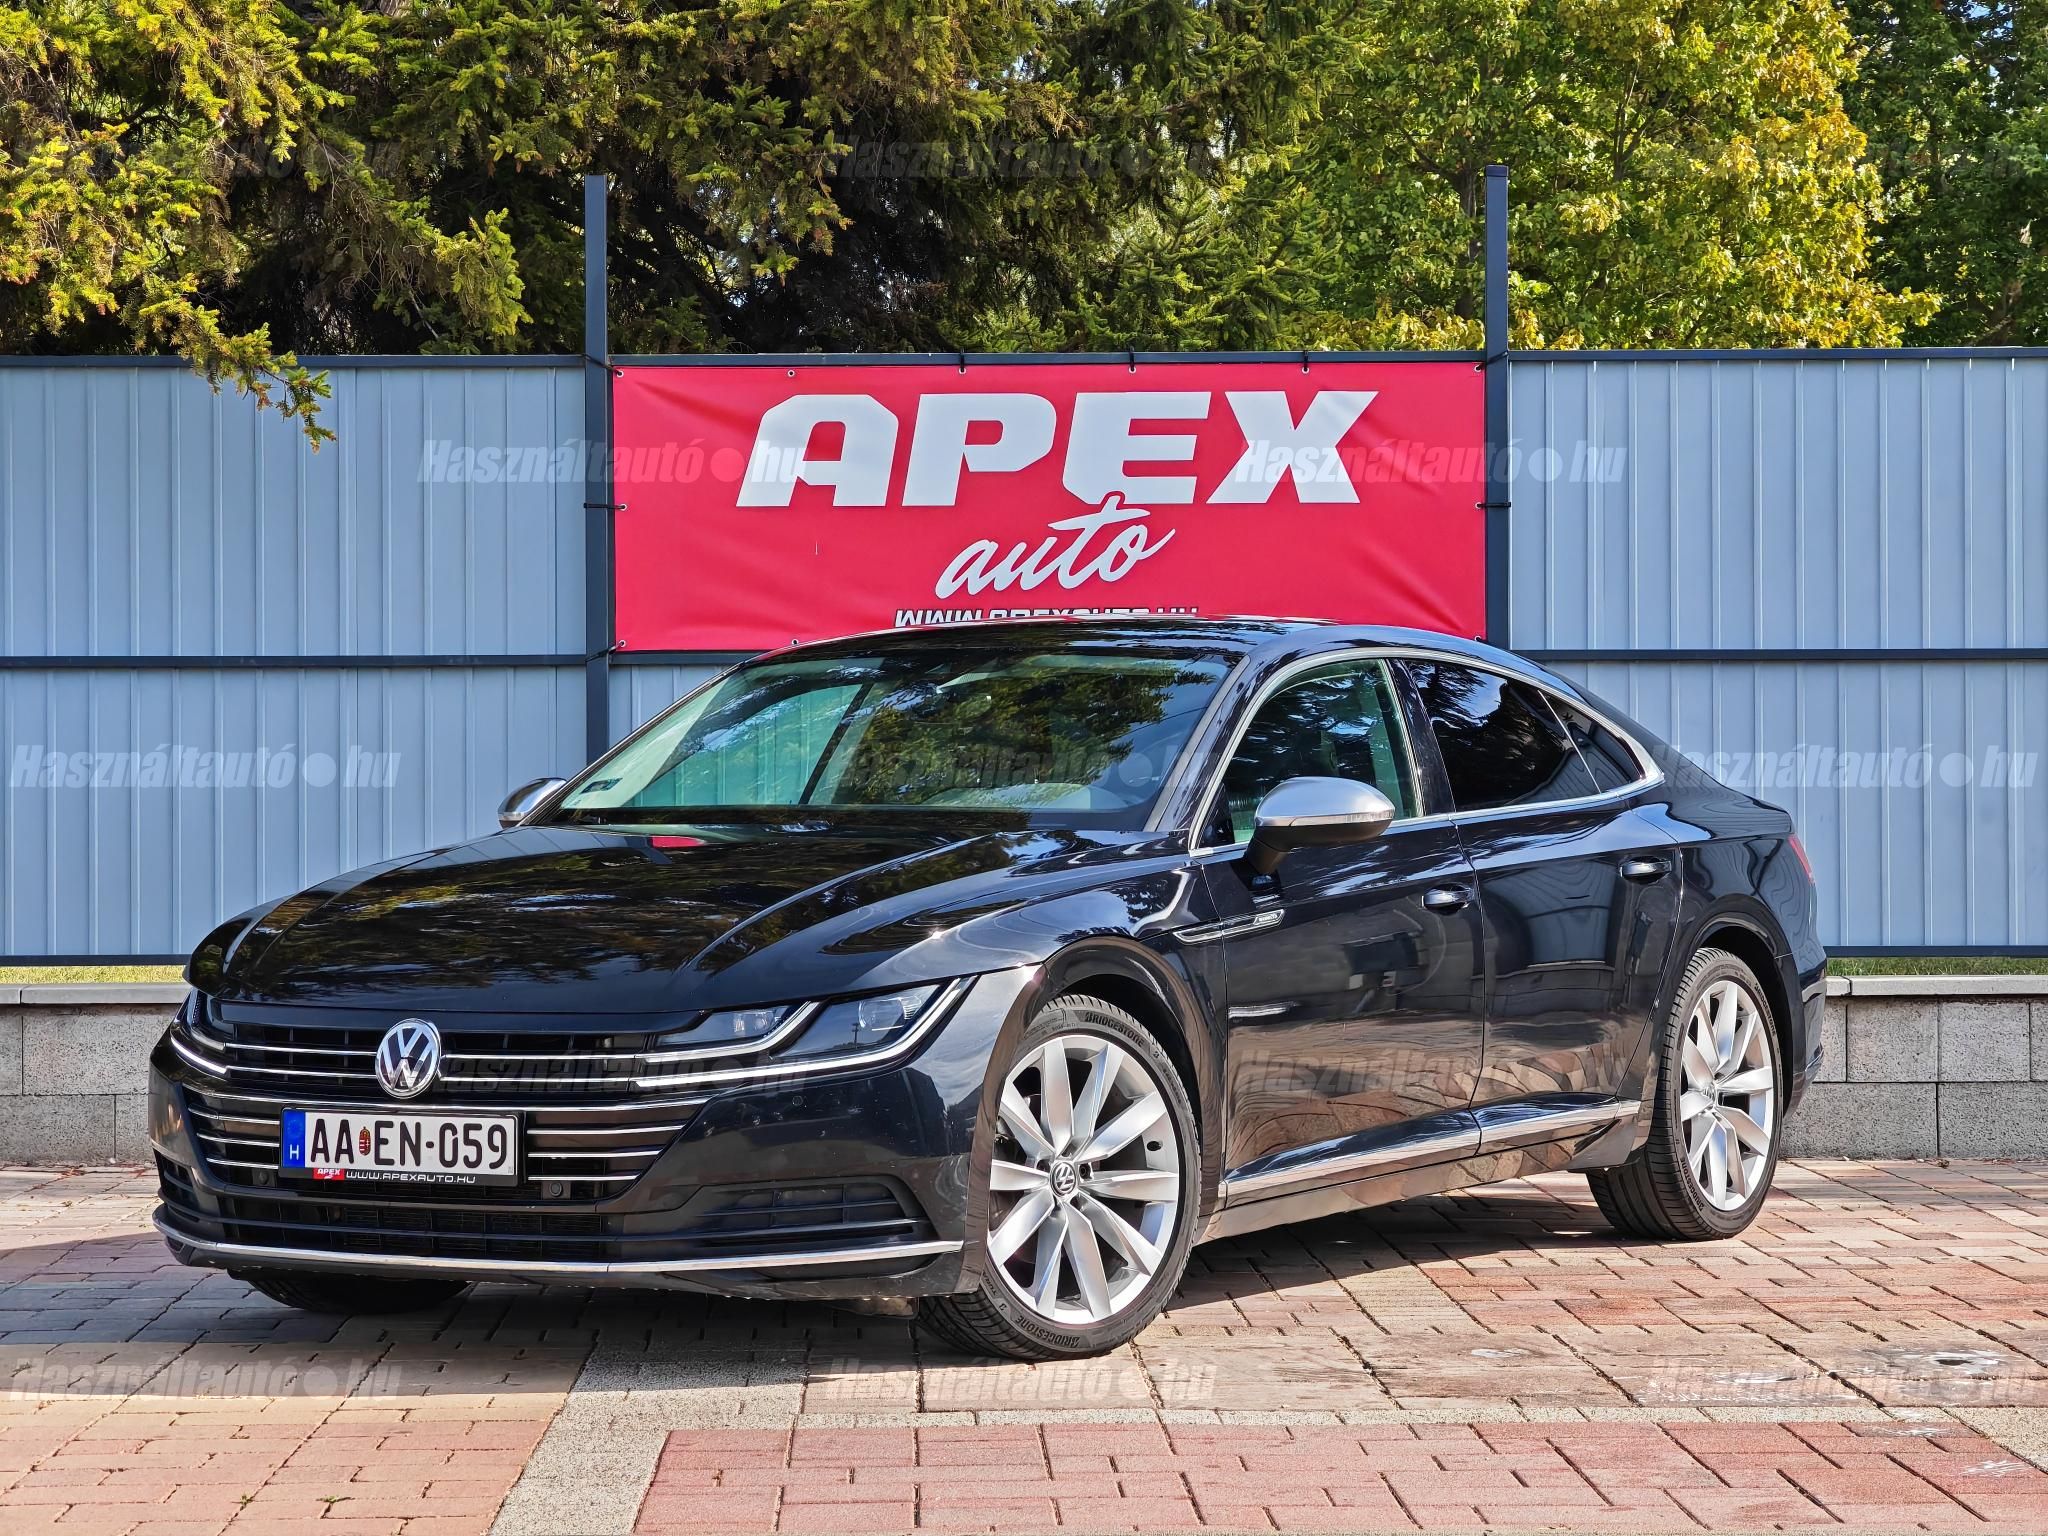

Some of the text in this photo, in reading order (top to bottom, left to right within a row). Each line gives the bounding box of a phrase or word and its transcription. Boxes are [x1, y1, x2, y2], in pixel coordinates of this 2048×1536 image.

[736, 390, 1380, 508] APEX
[934, 494, 1176, 599] auto
[1084, 1010, 1145, 1048] BRIDGESTONE
[289, 1145, 300, 1160] H
[310, 1118, 508, 1170] AA EN-059
[346, 1171, 476, 1184] WWW.APEXAUTO.HU
[1014, 1314, 1081, 1348] BRIDGESTONE
